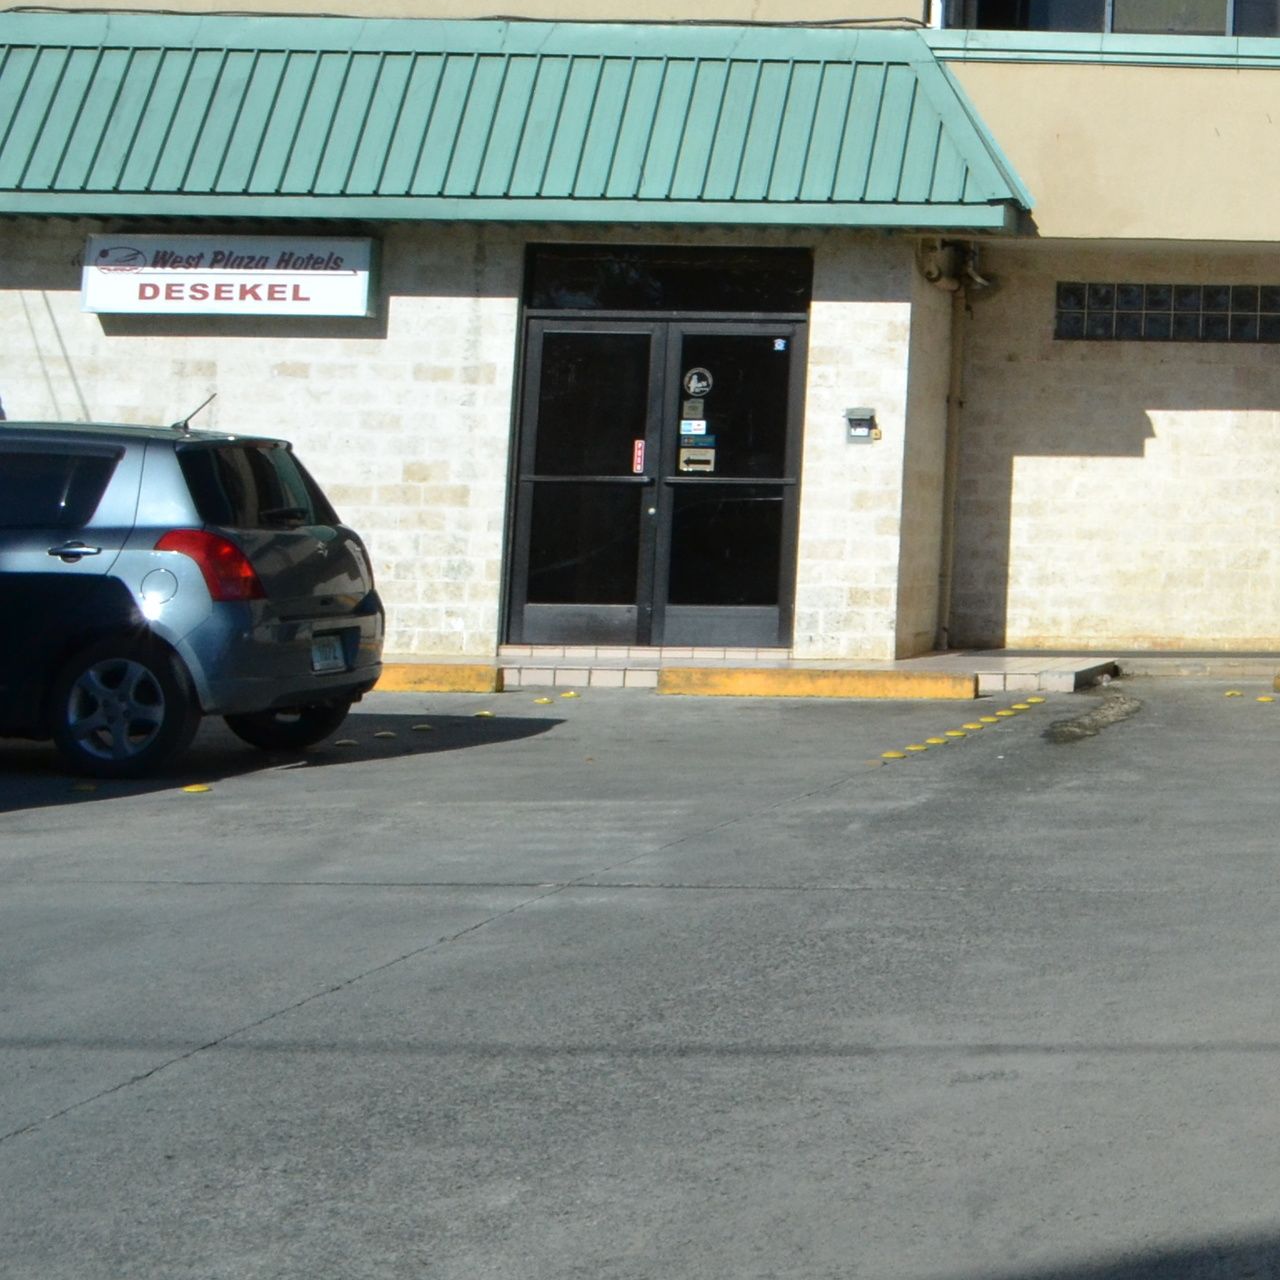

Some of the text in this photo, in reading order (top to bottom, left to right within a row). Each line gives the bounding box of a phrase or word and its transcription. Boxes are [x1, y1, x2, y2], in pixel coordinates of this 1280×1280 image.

[151, 249, 344, 271] West Plaza Hotels
[138, 282, 311, 302] DESEKEL
